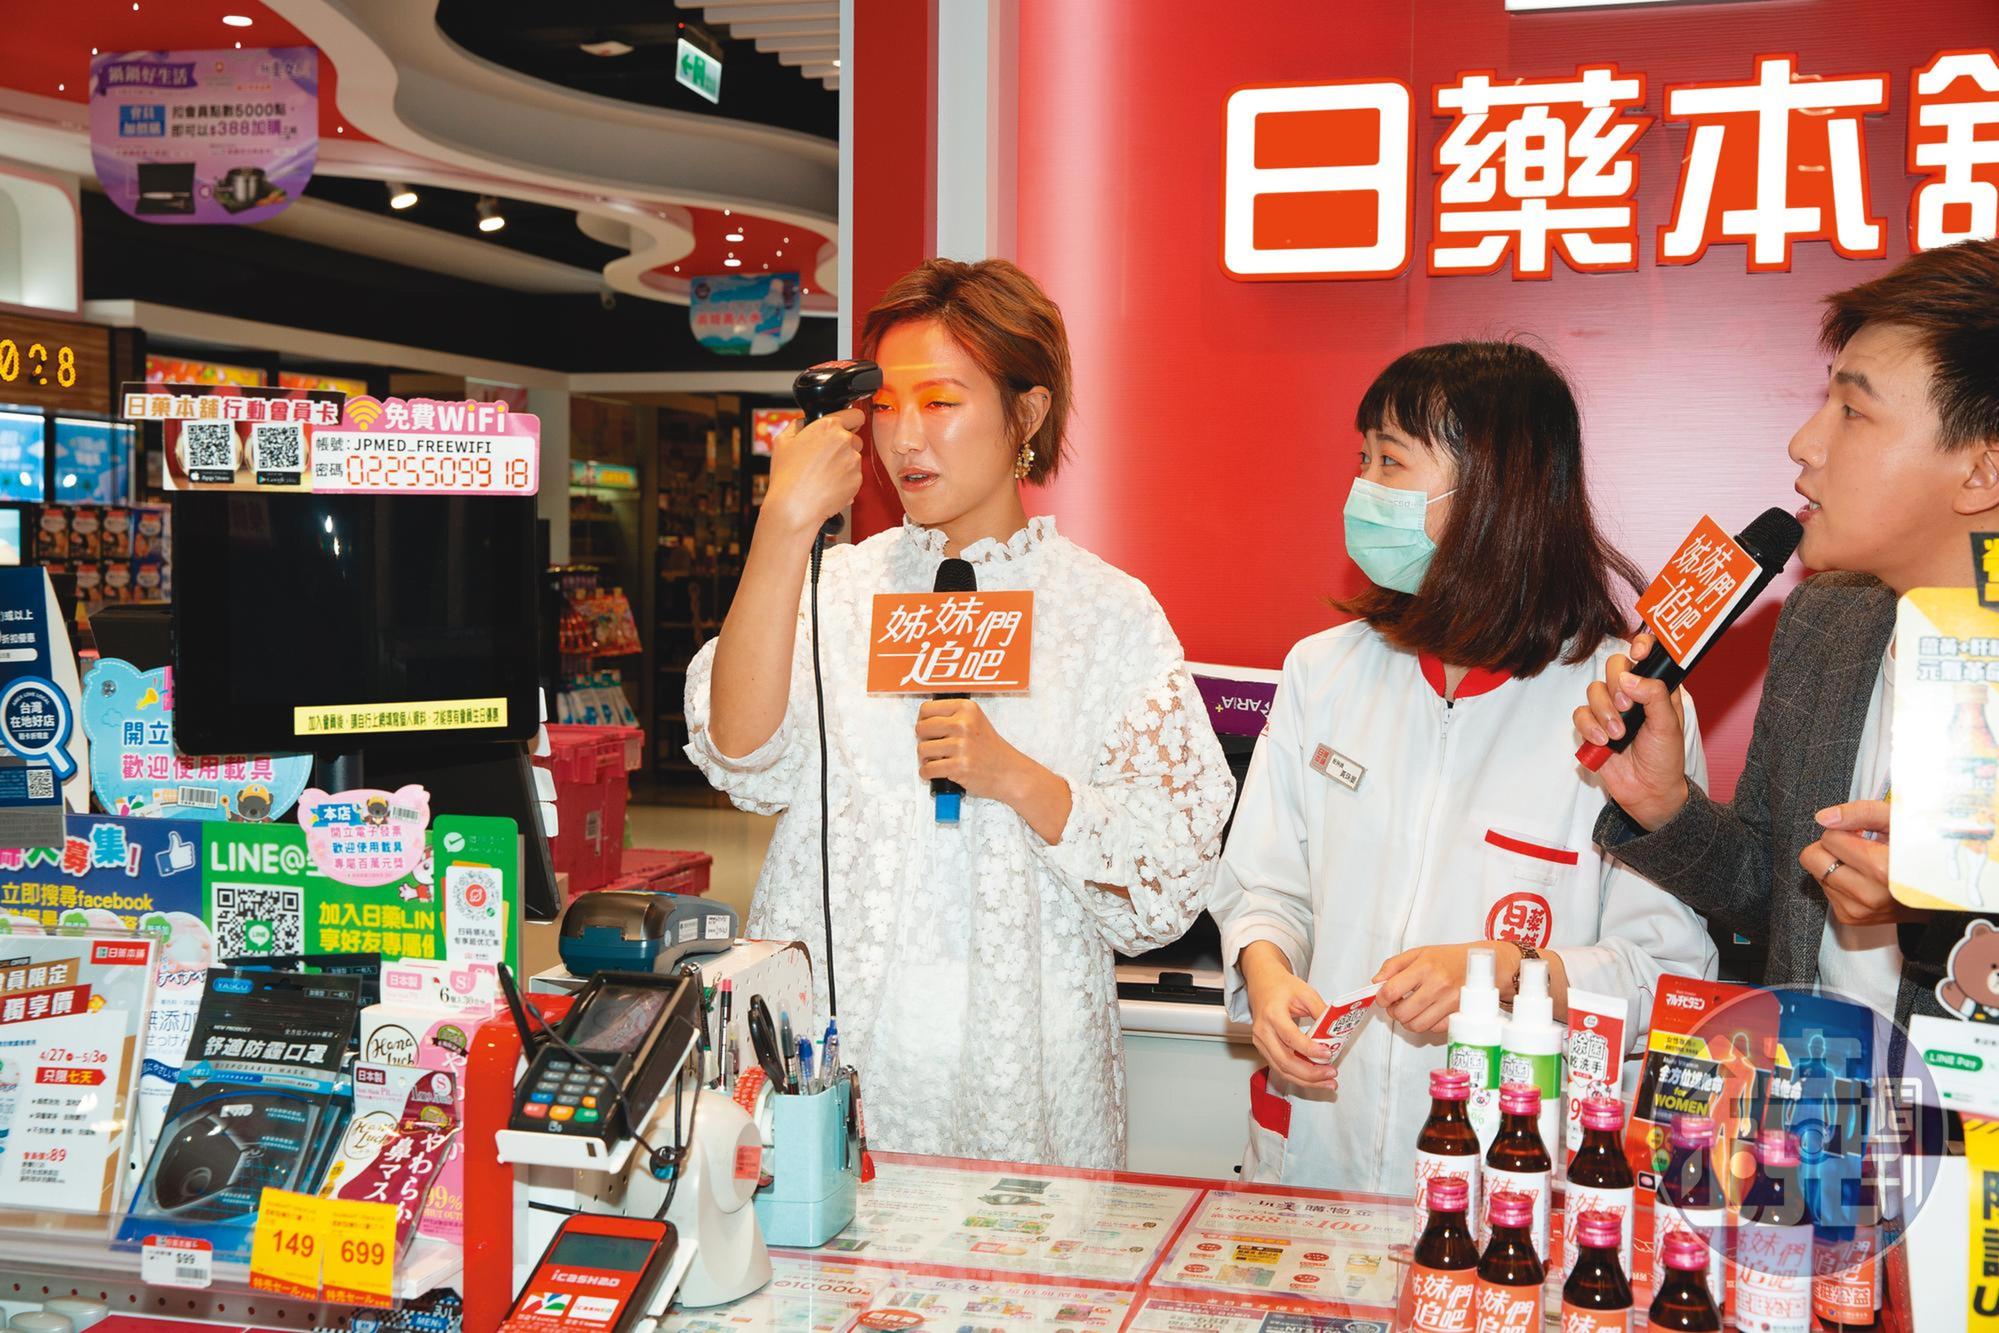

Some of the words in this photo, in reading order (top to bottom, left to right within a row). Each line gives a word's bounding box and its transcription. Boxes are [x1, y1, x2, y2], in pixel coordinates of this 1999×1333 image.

[123, 720, 170, 746] 開立
[121, 754, 274, 782] 歡迎使用載具
[323, 805, 351, 821] 本店
[357, 1070, 384, 1083] 日本製
[1655, 1093, 1710, 1117] WOMEN
[272, 1229, 315, 1258] 149
[341, 1240, 385, 1266] 699
